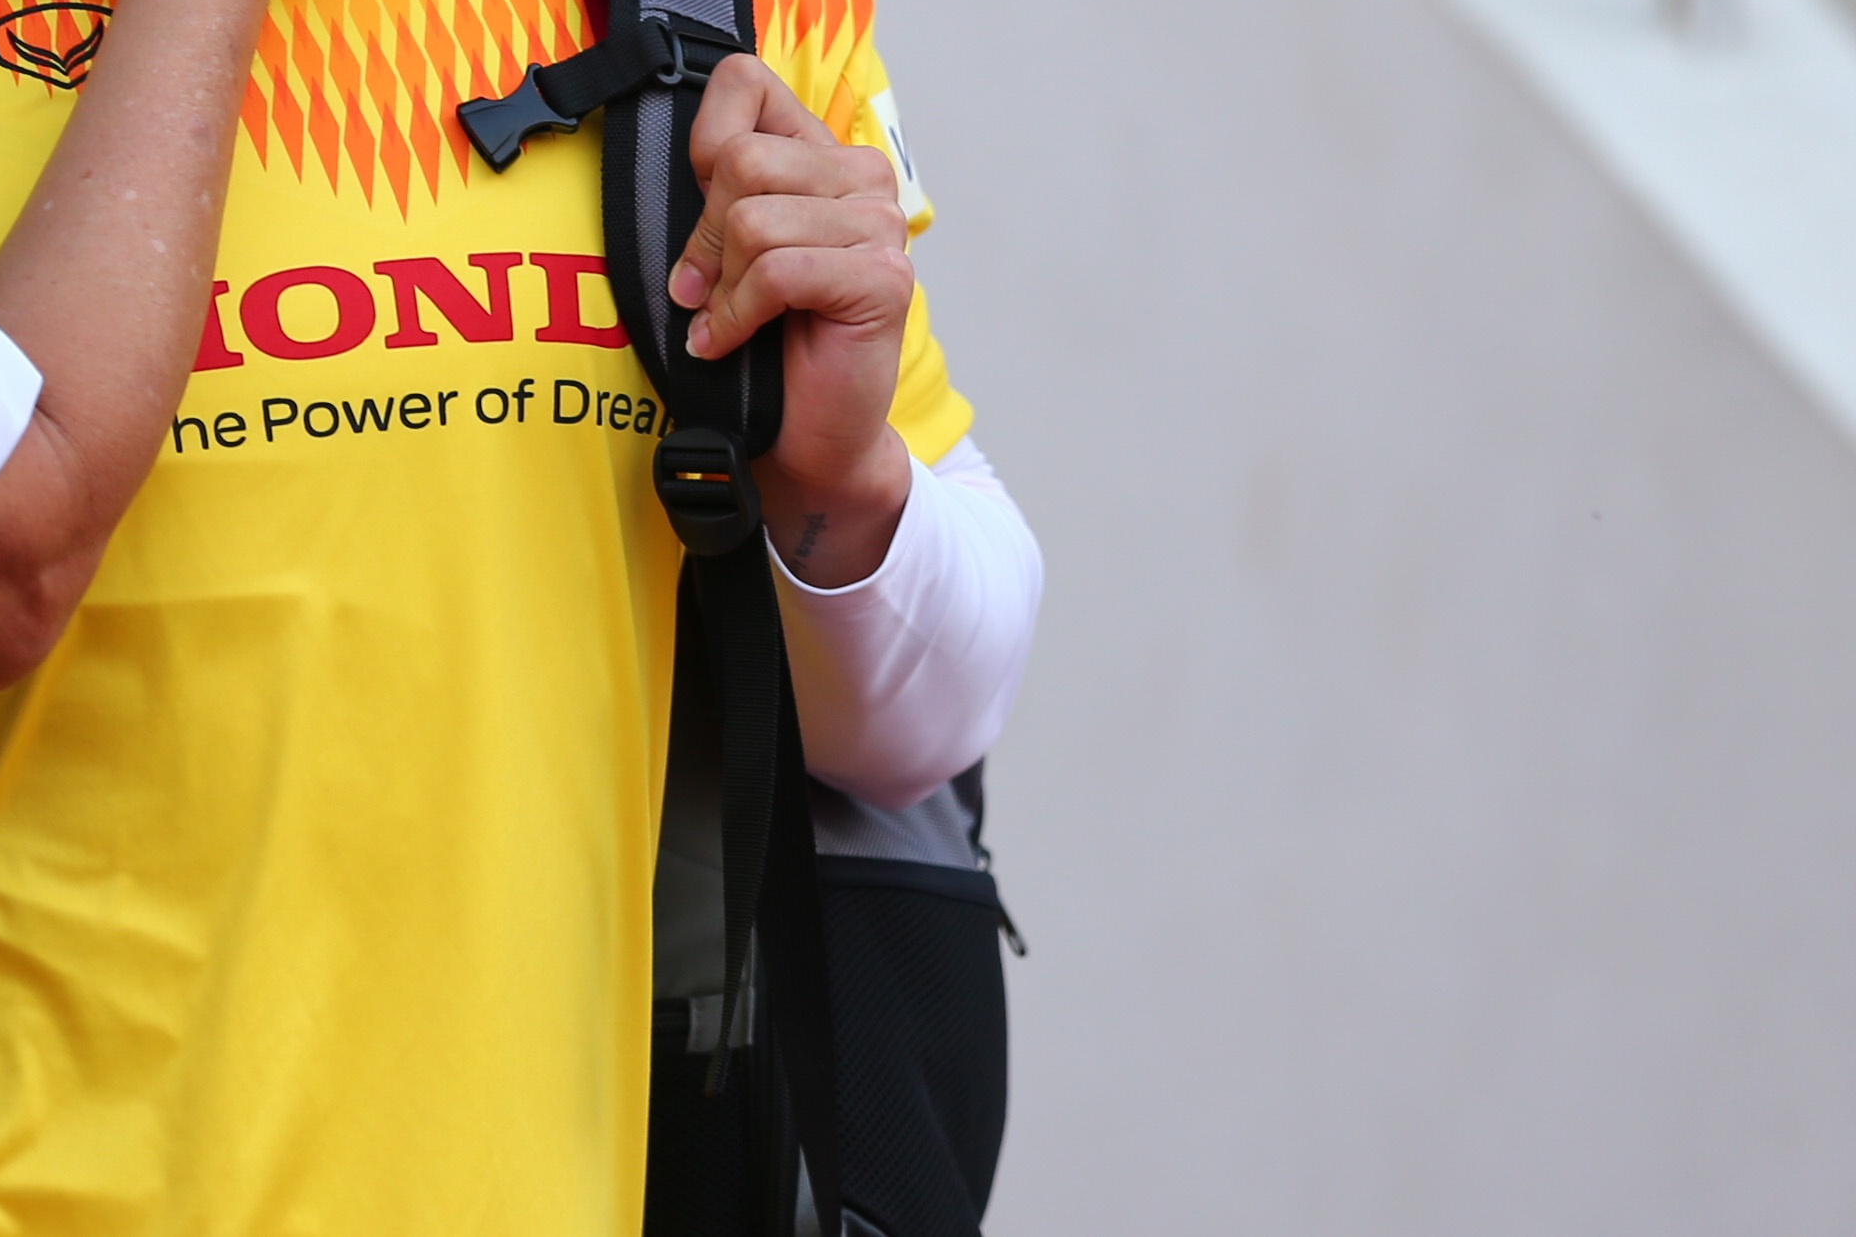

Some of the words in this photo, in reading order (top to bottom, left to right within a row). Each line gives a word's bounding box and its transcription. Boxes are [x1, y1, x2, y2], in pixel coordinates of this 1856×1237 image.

[190, 251, 633, 373] OND
[171, 412, 247, 454] he
[261, 389, 460, 443] Power
[475, 378, 535, 426] of
[553, 378, 674, 439] Drea
